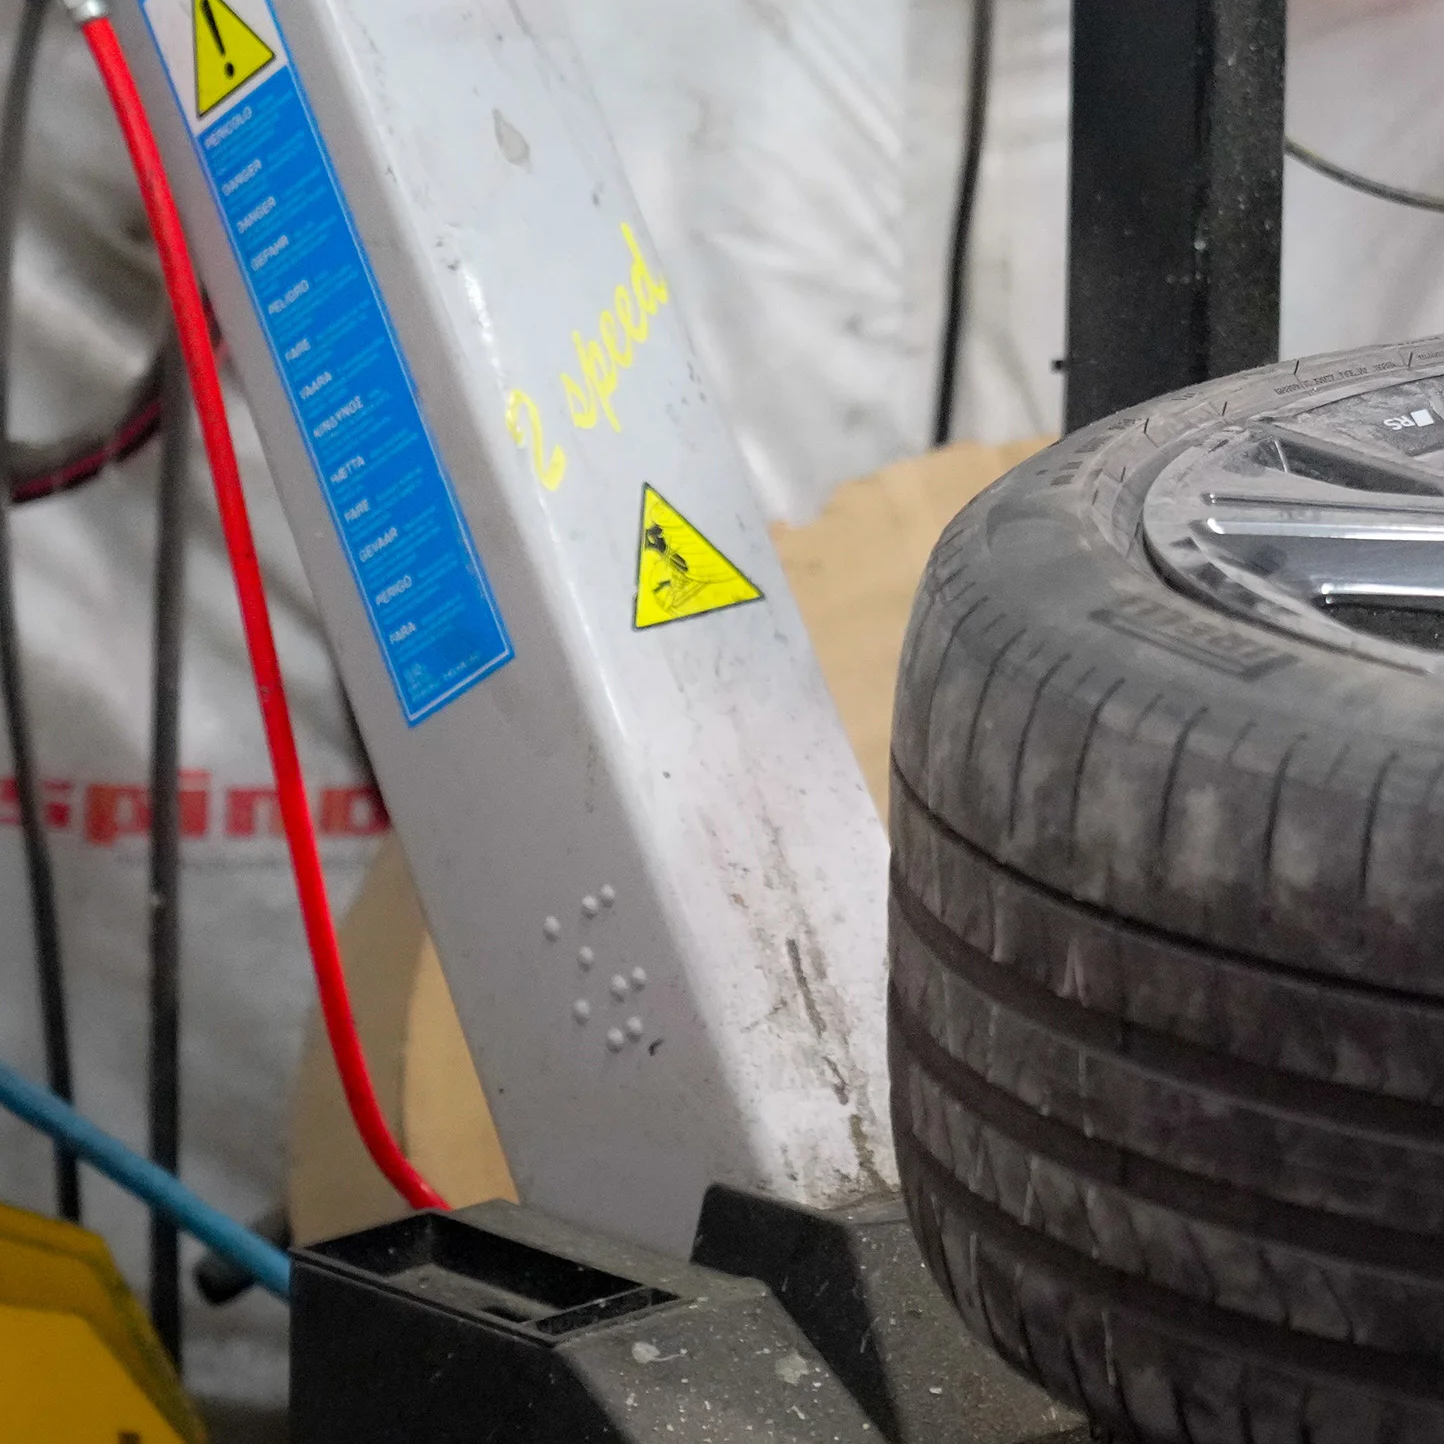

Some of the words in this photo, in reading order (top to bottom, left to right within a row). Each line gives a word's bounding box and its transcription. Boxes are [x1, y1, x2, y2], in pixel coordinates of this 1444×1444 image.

[222, 159, 262, 196] DANGER
[237, 196, 276, 233] DANGER
[251, 235, 289, 271] GEFAHR
[268, 280, 309, 314] PELIGRO
[507, 390, 566, 490] 2
[559, 223, 669, 432] speed
[1383, 415, 1415, 431] RS
[359, 527, 398, 562] GEVAAR
[376, 574, 412, 605] PERIGO
